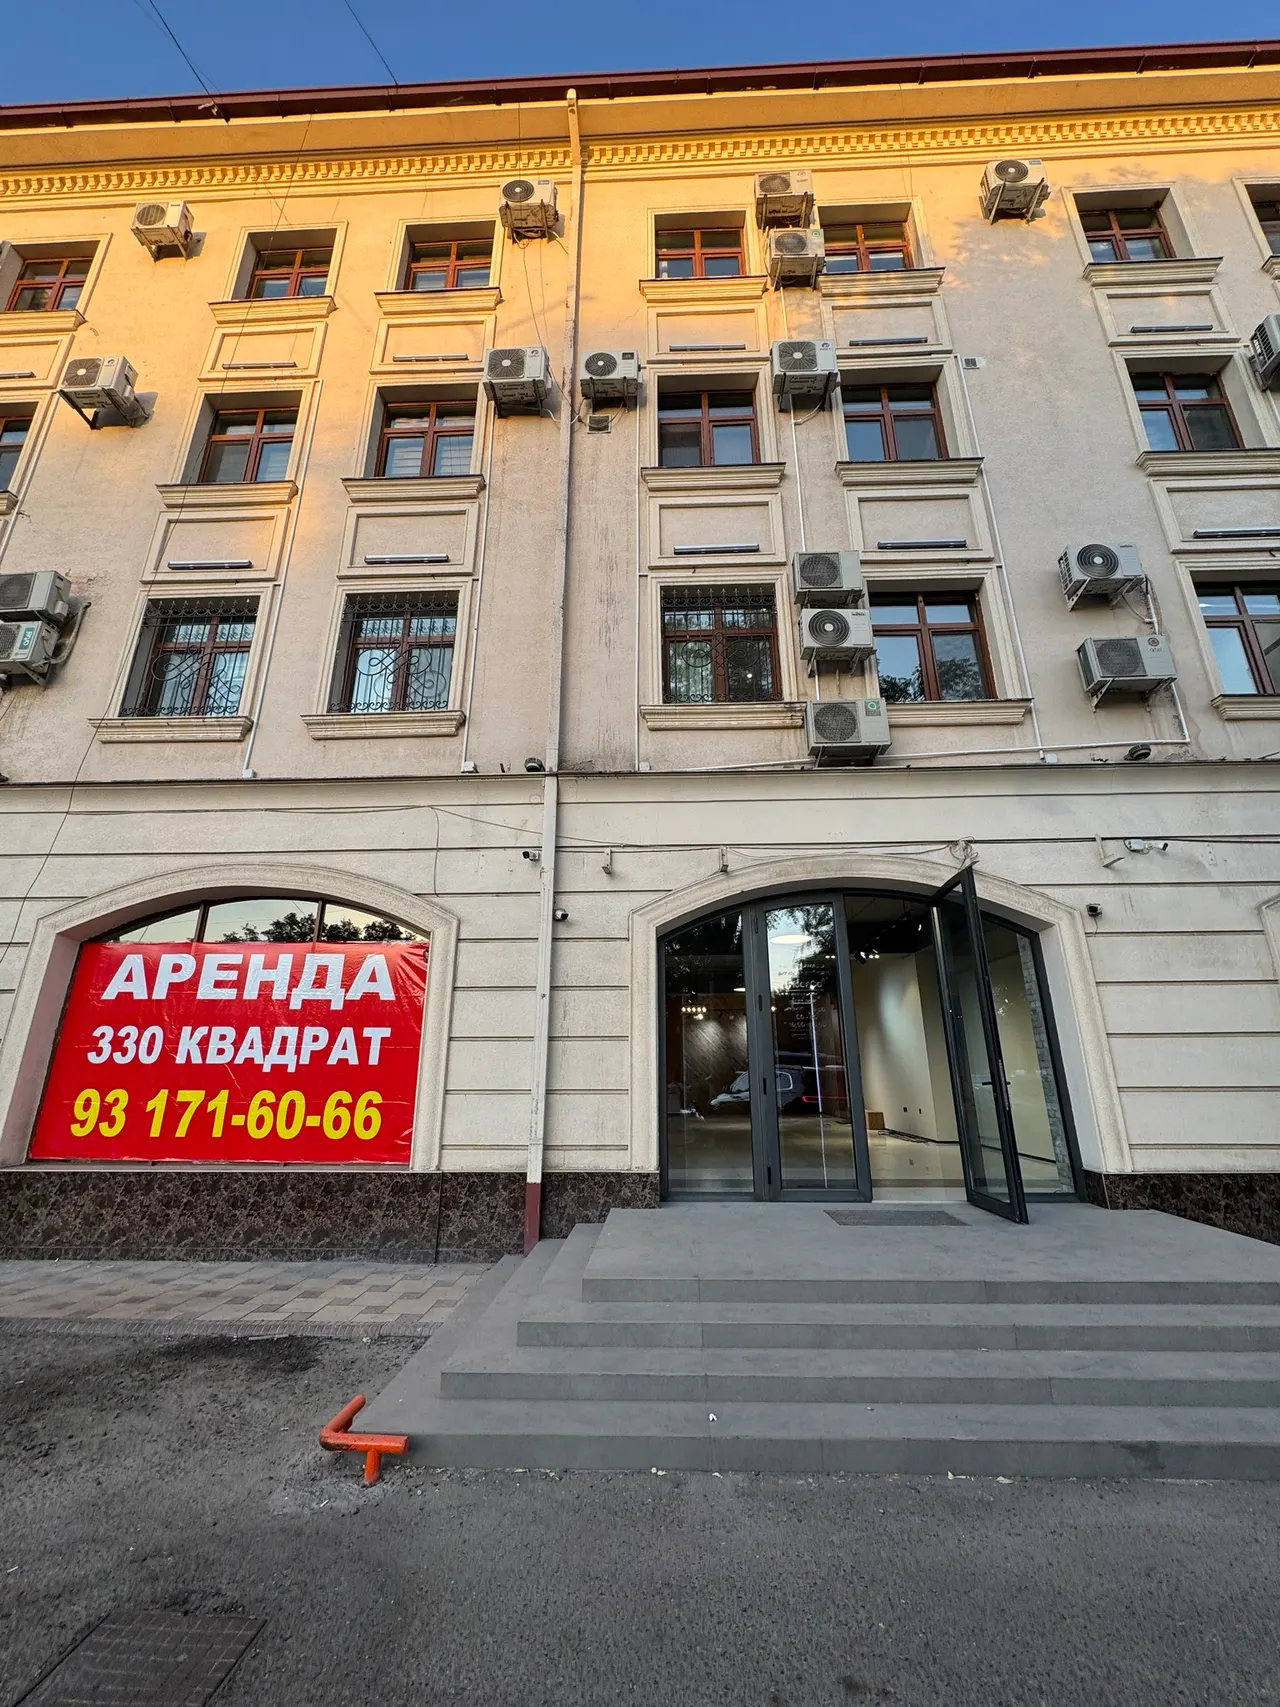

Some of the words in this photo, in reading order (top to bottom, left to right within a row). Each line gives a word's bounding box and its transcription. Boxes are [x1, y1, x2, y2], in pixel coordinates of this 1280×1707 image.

[101, 953, 395, 1010] АРЕНДА
[88, 1026, 163, 1064] 330
[175, 1026, 391, 1072] КВАДРАТ
[71, 1089, 128, 1137] 93
[146, 1090, 383, 1139] 171-60-66
